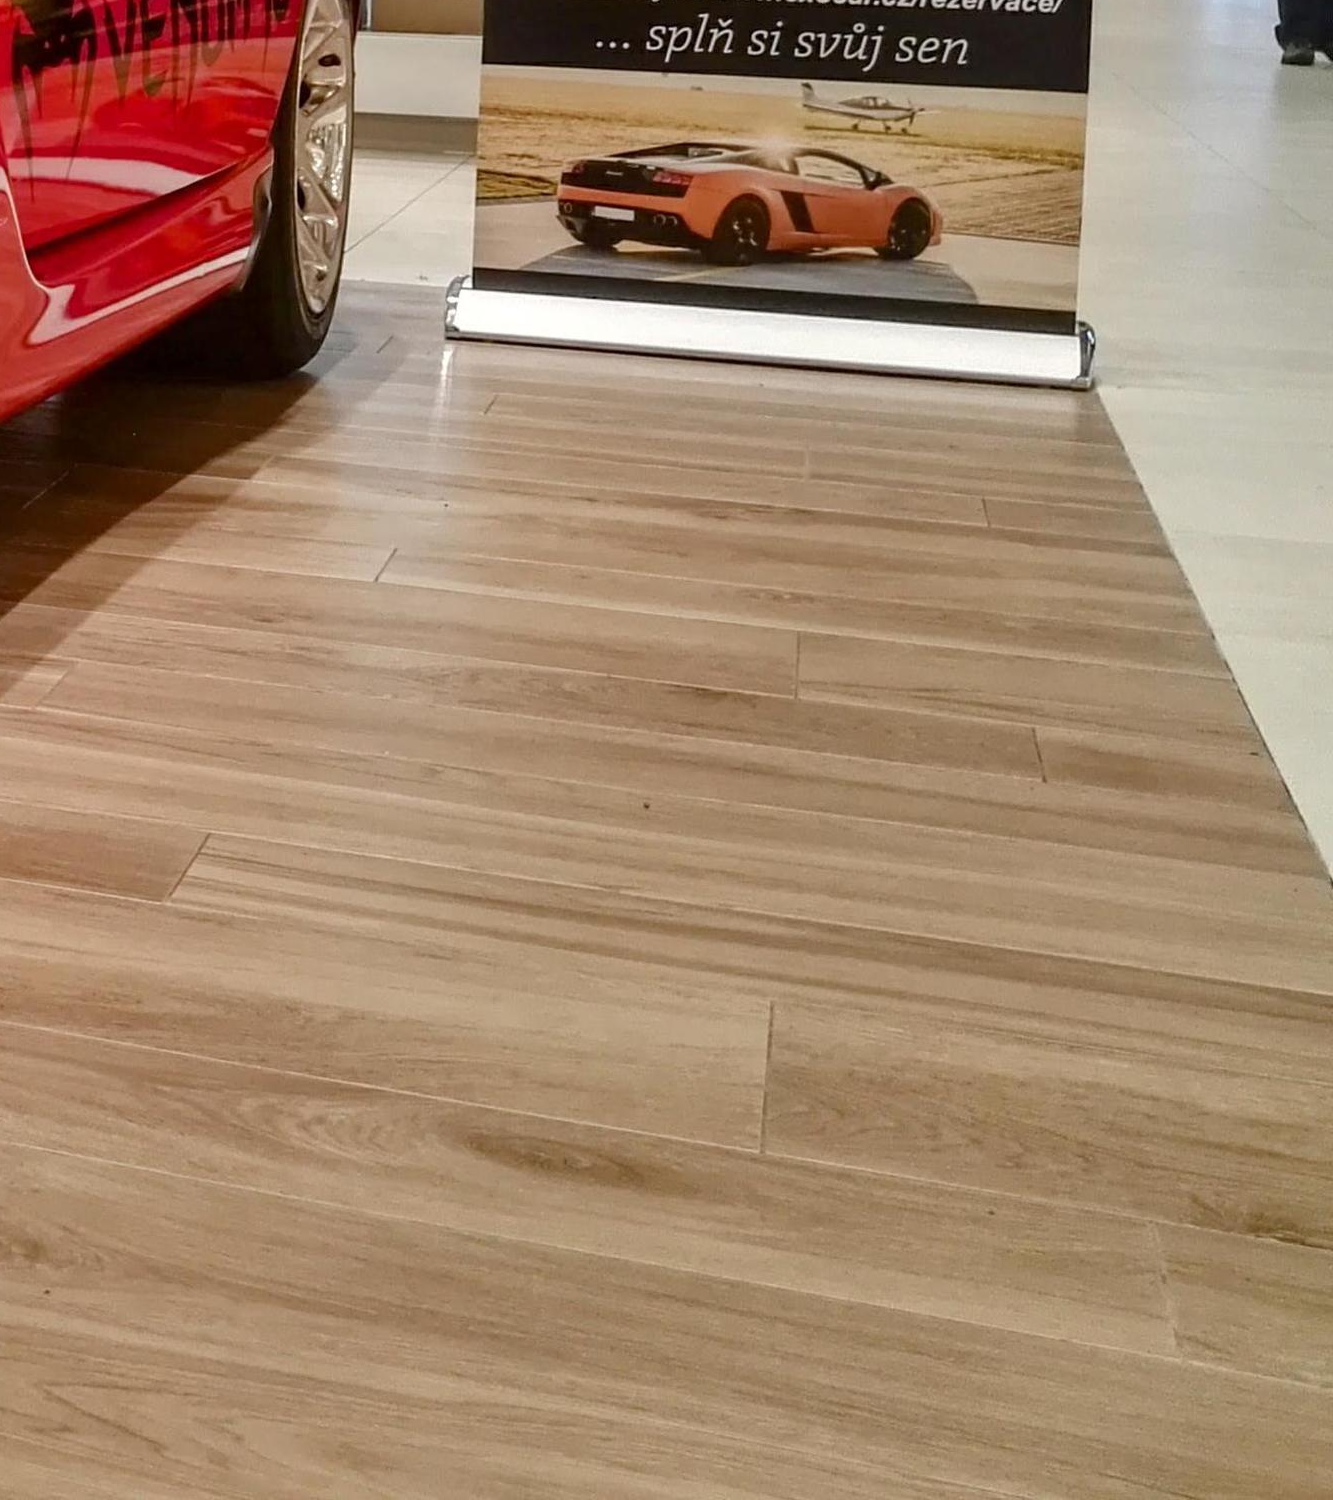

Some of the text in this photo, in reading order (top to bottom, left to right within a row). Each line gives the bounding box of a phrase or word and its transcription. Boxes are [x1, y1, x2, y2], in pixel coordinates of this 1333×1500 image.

[645, 13, 734, 64] splň
[747, 19, 781, 57] si
[794, 25, 882, 72] svůj
[895, 36, 969, 66] sen
